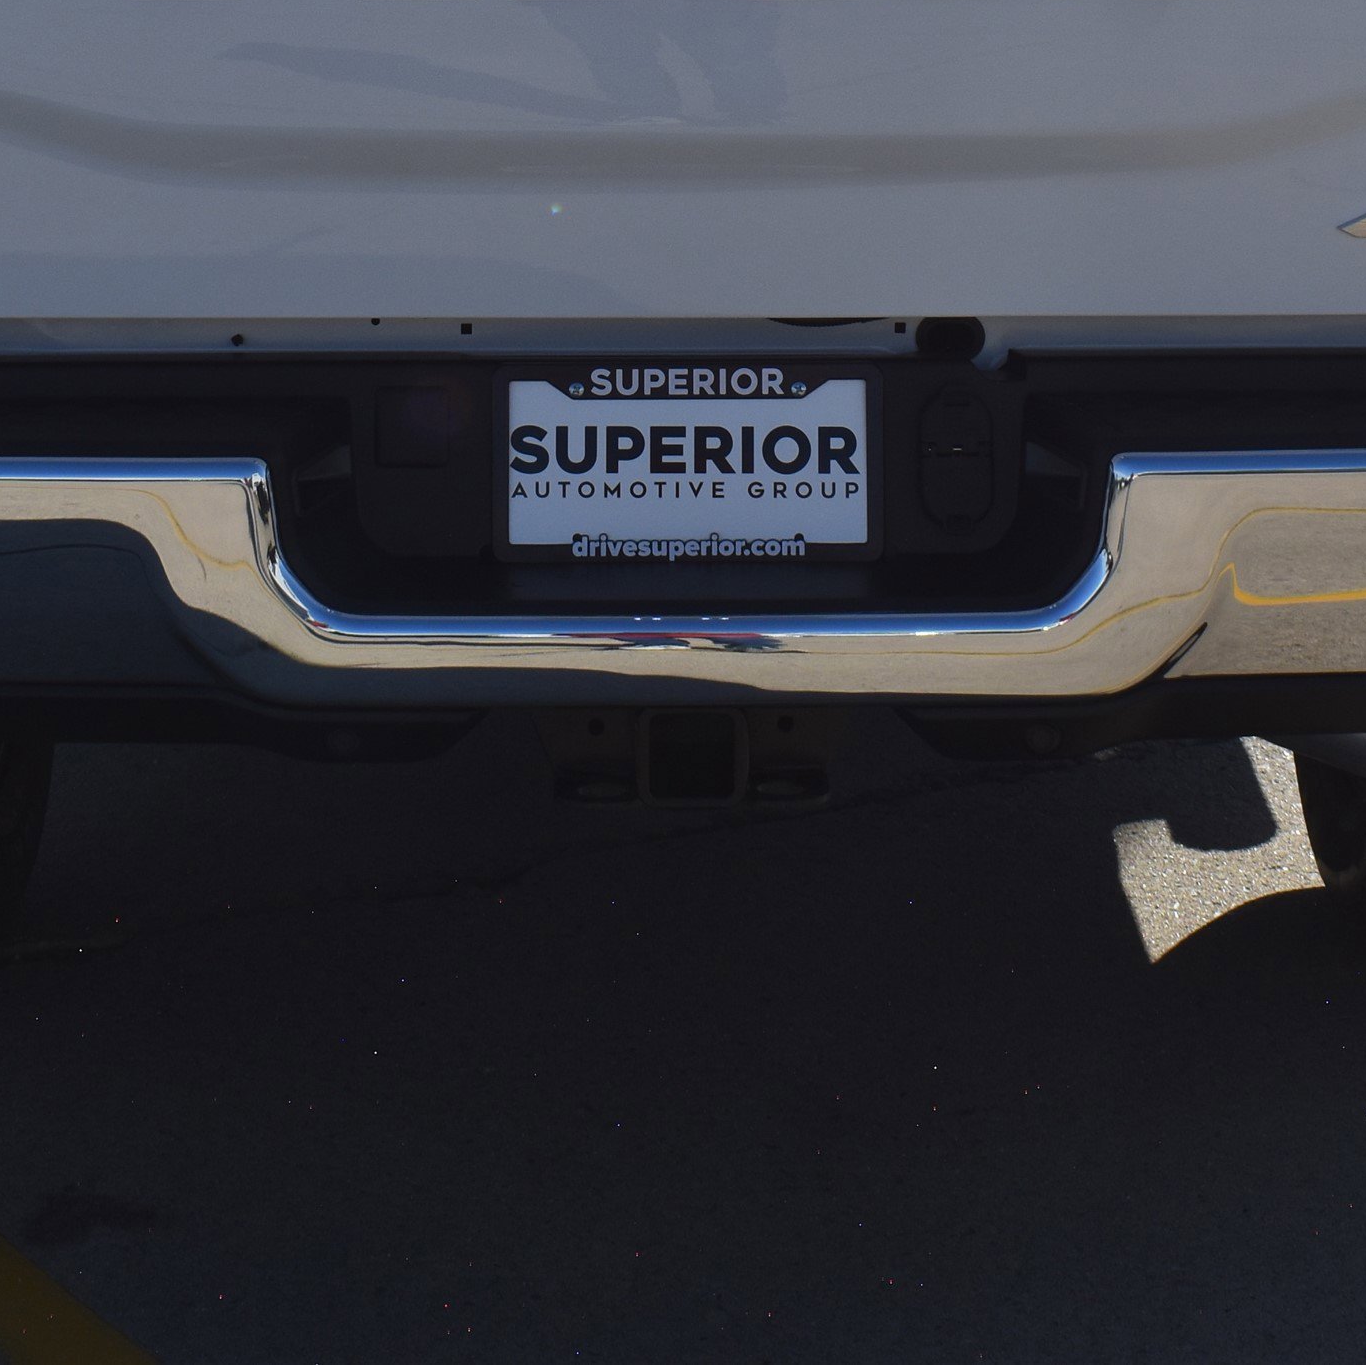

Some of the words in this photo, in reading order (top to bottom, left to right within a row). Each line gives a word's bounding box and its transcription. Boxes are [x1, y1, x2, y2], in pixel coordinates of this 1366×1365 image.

[590, 367, 785, 396] SUPERIOR
[509, 424, 861, 475] SUPERIOR
[511, 480, 726, 499] AUTOMOTIVE
[747, 480, 860, 499] GROUP
[572, 535, 806, 561] drivesuperior.com
